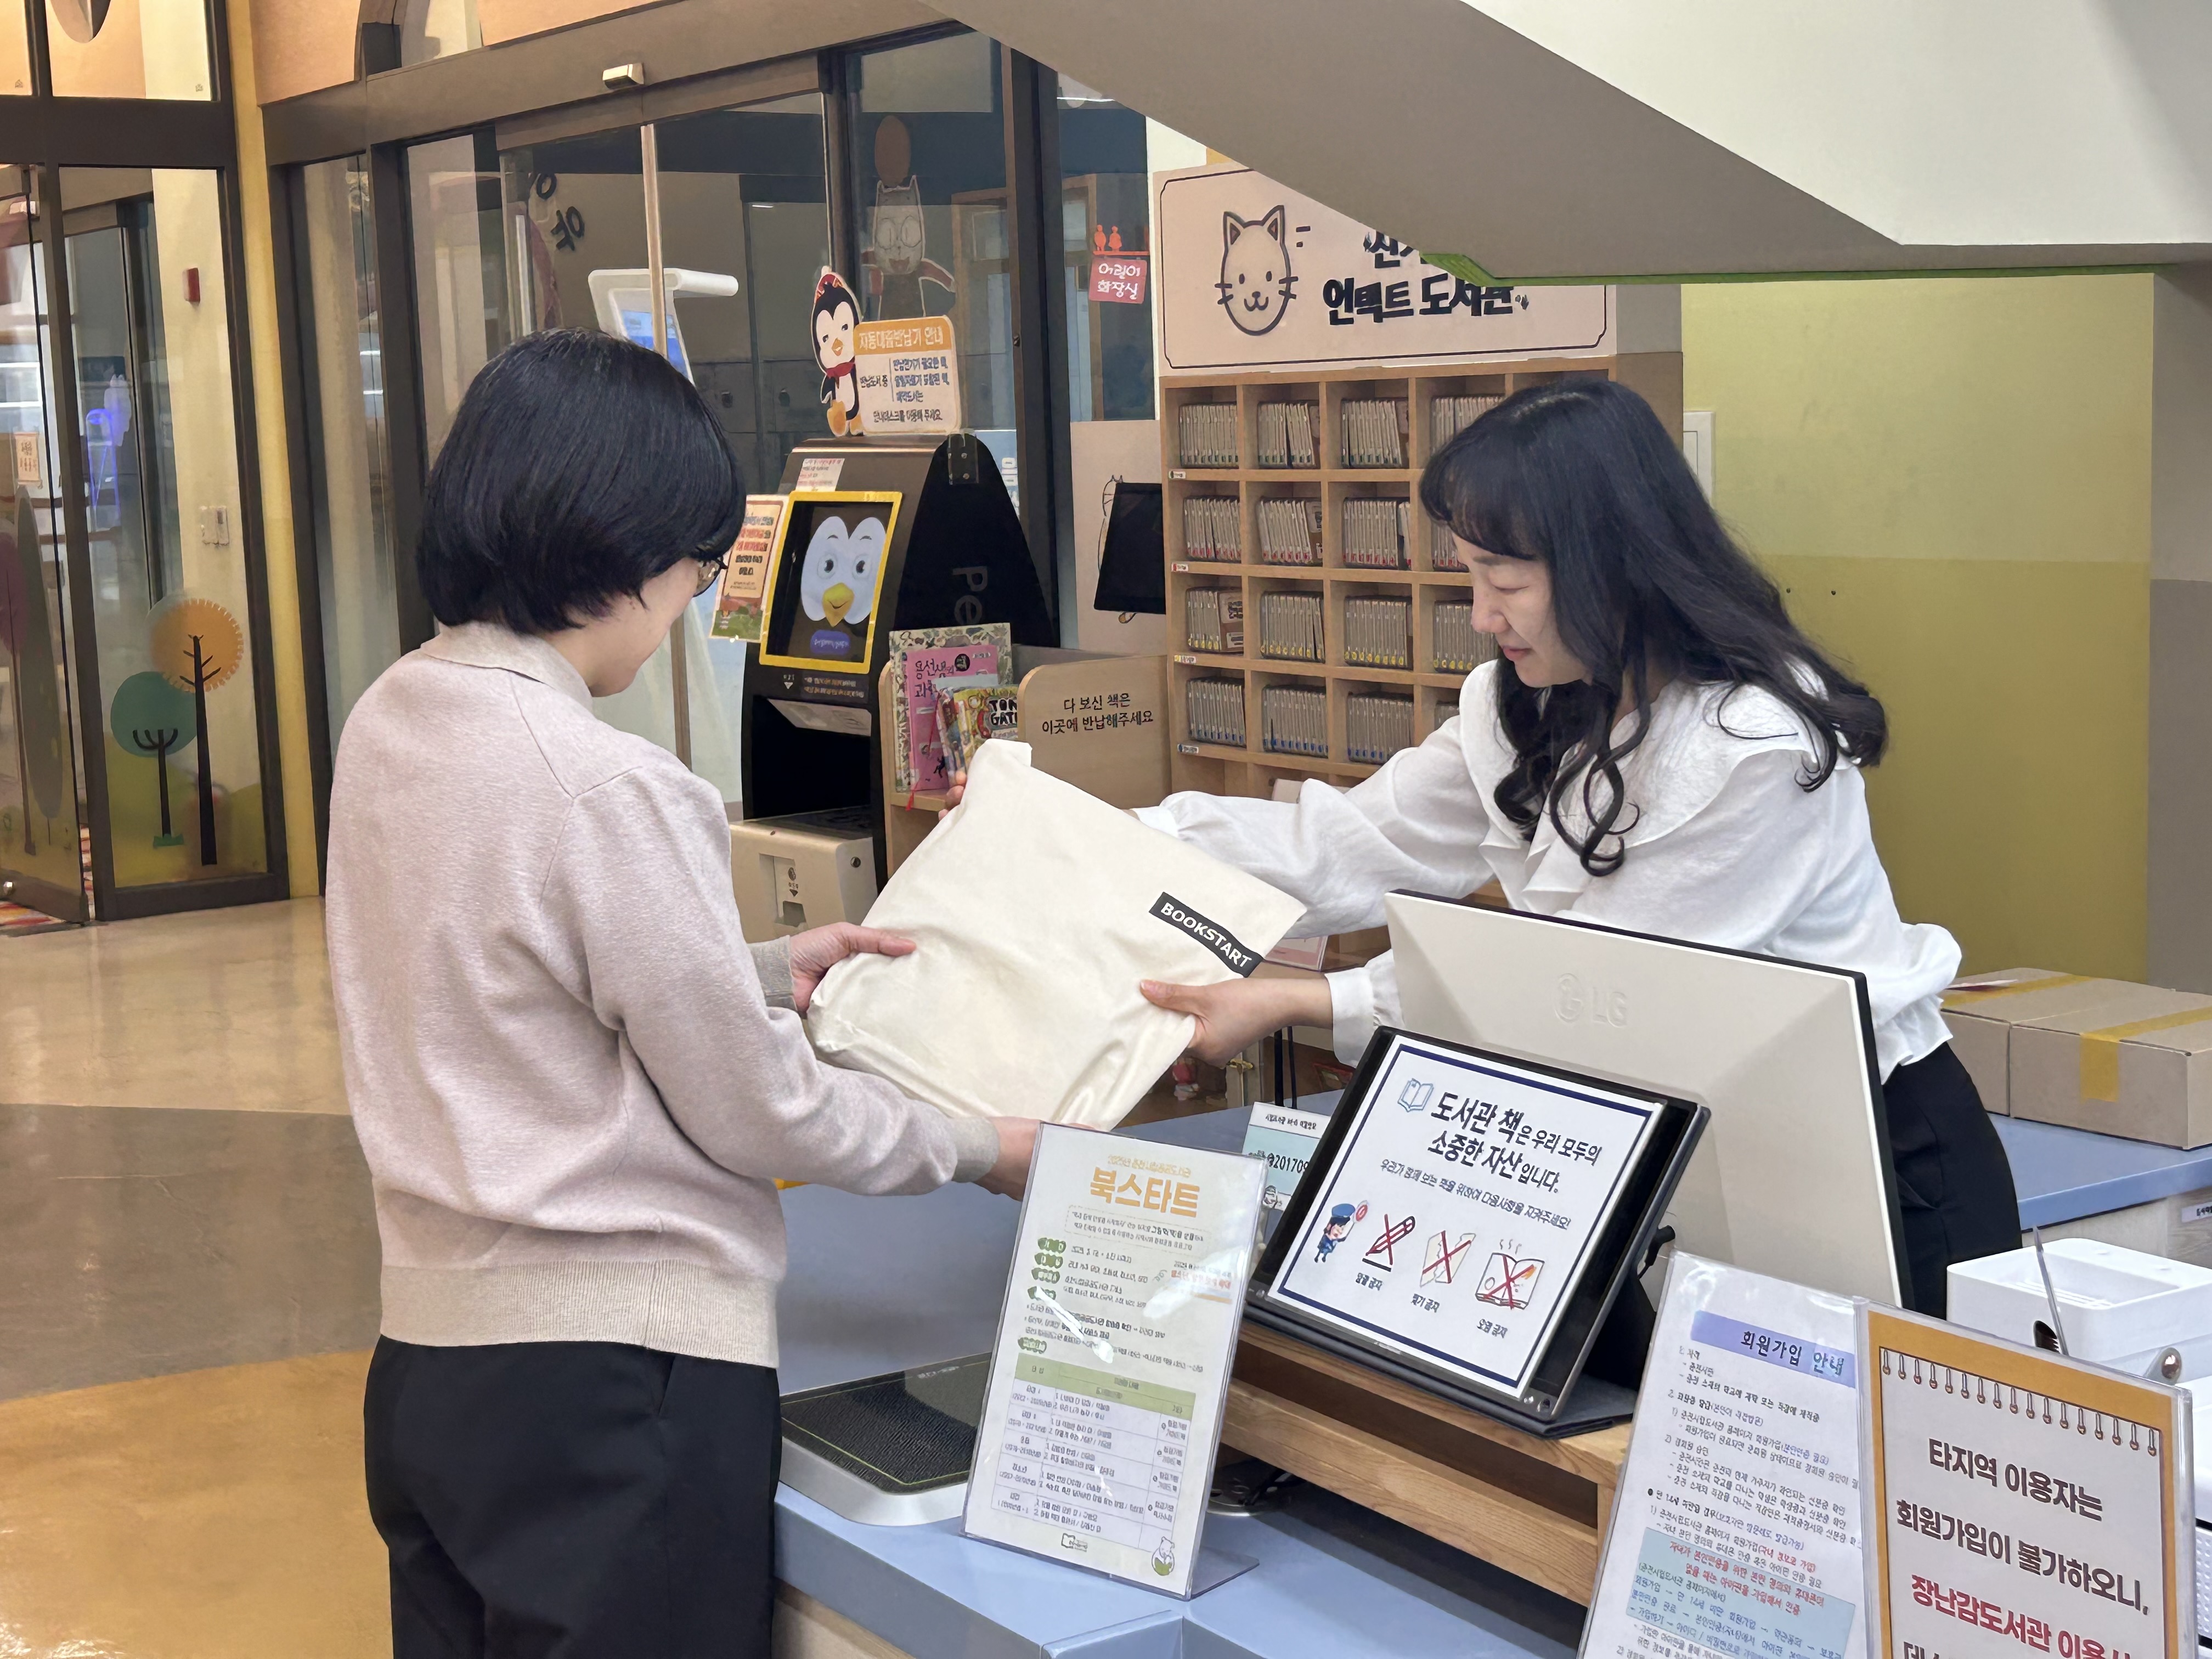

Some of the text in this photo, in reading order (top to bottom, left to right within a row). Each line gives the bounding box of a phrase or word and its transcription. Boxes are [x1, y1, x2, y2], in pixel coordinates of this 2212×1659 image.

[1097, 279, 1138, 300] 화장실
[1098, 263, 1141, 279] 어린이
[991, 712, 1018, 726] GAT
[1042, 710, 1154, 735] 이곳에 반납해주세요
[1064, 698, 1075, 713] 다
[1080, 695, 1102, 710] 보신
[1160, 902, 1252, 968] BOOKSTART
[1427, 1130, 1485, 1167] 소중한
[1430, 1092, 1499, 1135] 도서관
[1532, 1130, 1561, 1154] 우리
[1558, 1137, 1602, 1166] 모두의
[1090, 1166, 1200, 1218] 북스타트
[1741, 1331, 1844, 1376] 회원가입 안내
[1928, 1438, 2103, 1521] 타지역 이용자는
[1896, 1499, 2149, 1616] 회원가입이 불가하오니,
[1911, 1574, 2052, 1652] 장난감도서관
